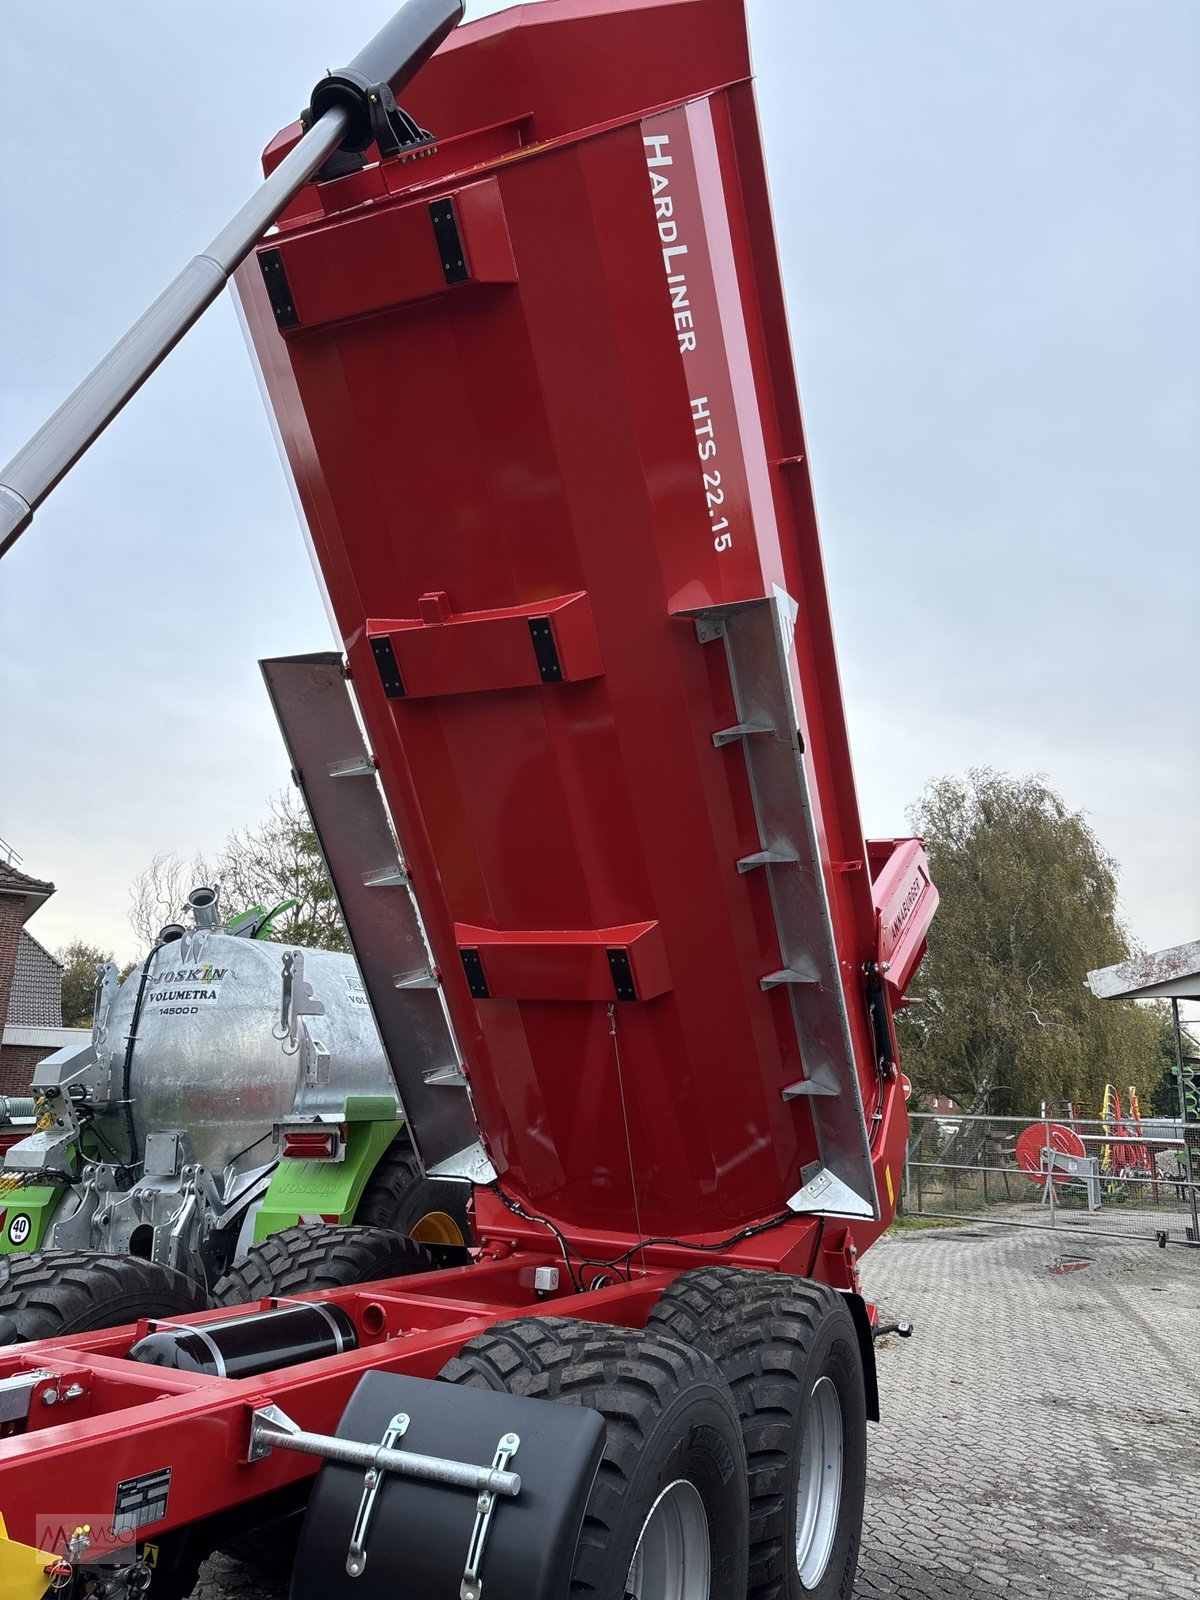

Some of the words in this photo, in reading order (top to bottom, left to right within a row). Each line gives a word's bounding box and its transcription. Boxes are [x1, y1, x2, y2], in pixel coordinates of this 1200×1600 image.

[690, 395, 717, 461] HTS
[701, 468, 733, 553] 22.15
[153, 967, 228, 985] JOSKIN
[150, 990, 217, 1002] VOLUMETRA
[13, 1219, 26, 1233] 40
